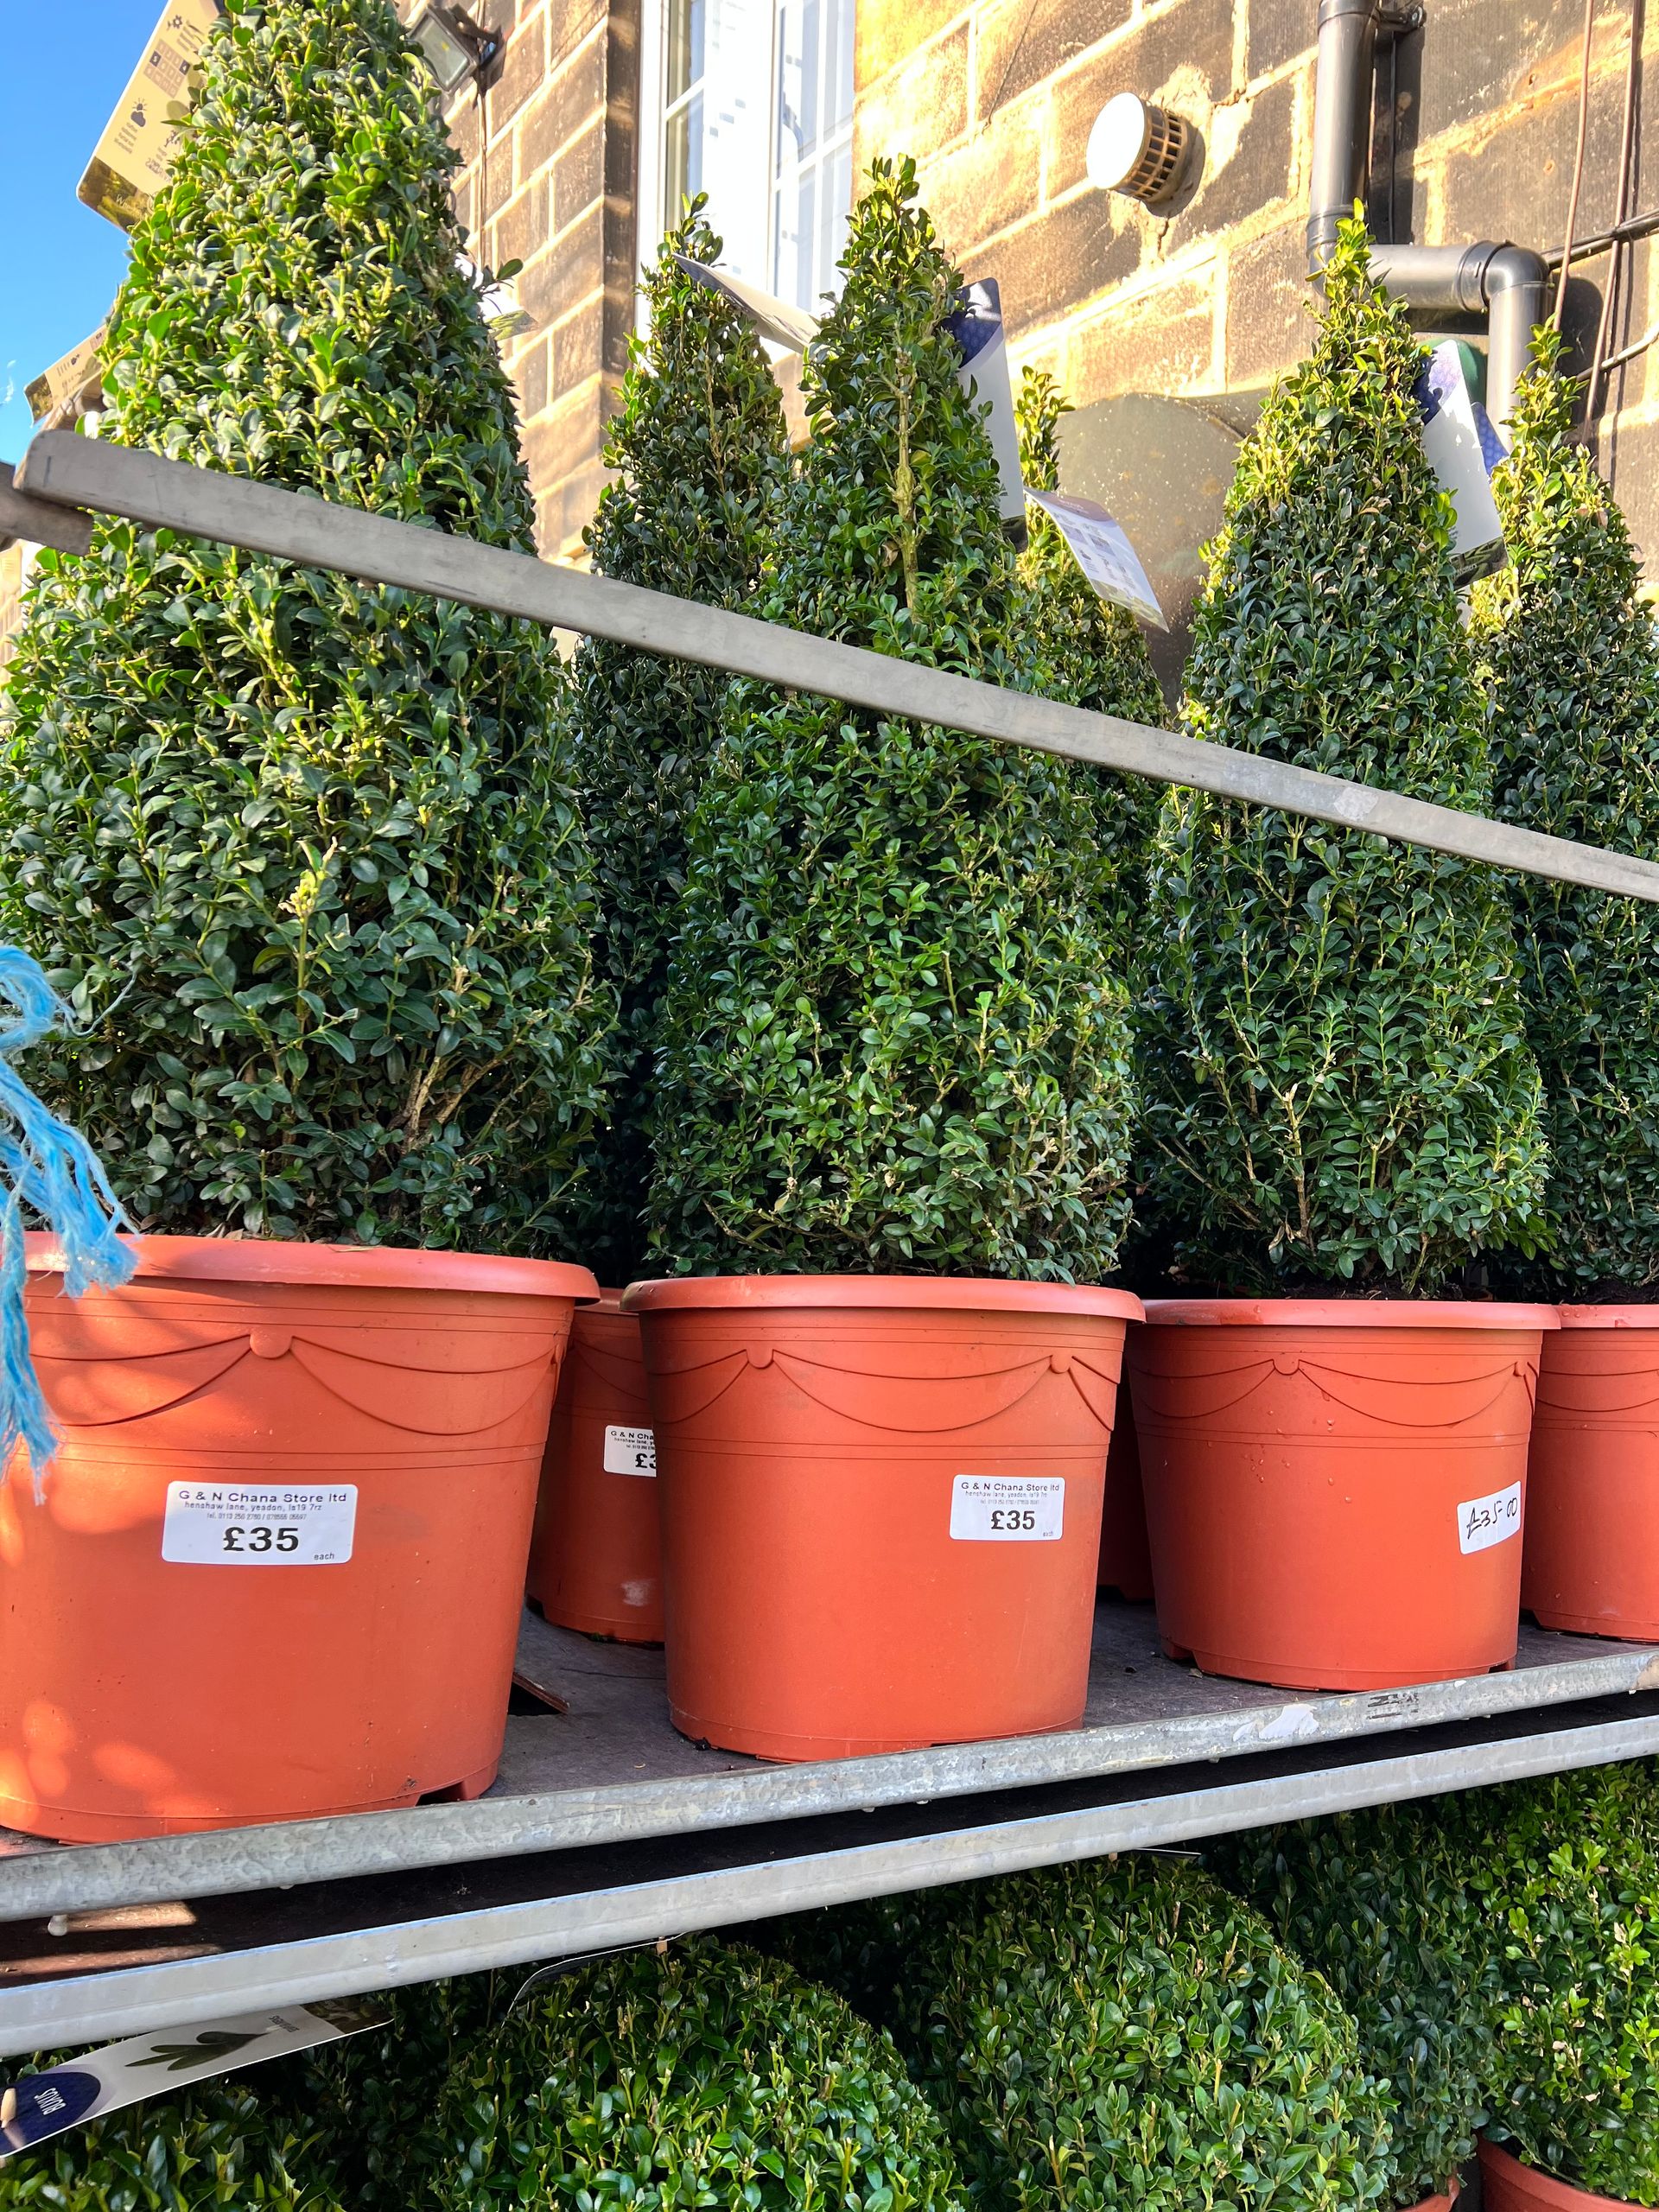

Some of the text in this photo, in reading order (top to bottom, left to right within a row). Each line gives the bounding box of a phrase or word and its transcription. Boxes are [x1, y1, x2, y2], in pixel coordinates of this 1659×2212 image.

[179, 1491, 346, 1503] G & N Chana Store ltd
[184, 1501, 224, 1510] henshaw
[226, 1503, 248, 1511] lane,
[251, 1503, 286, 1512] yeadon,
[991, 1510, 1035, 1530] £35
[223, 1527, 299, 1552] £35
[34, 2088, 67, 2115] BUXUS
